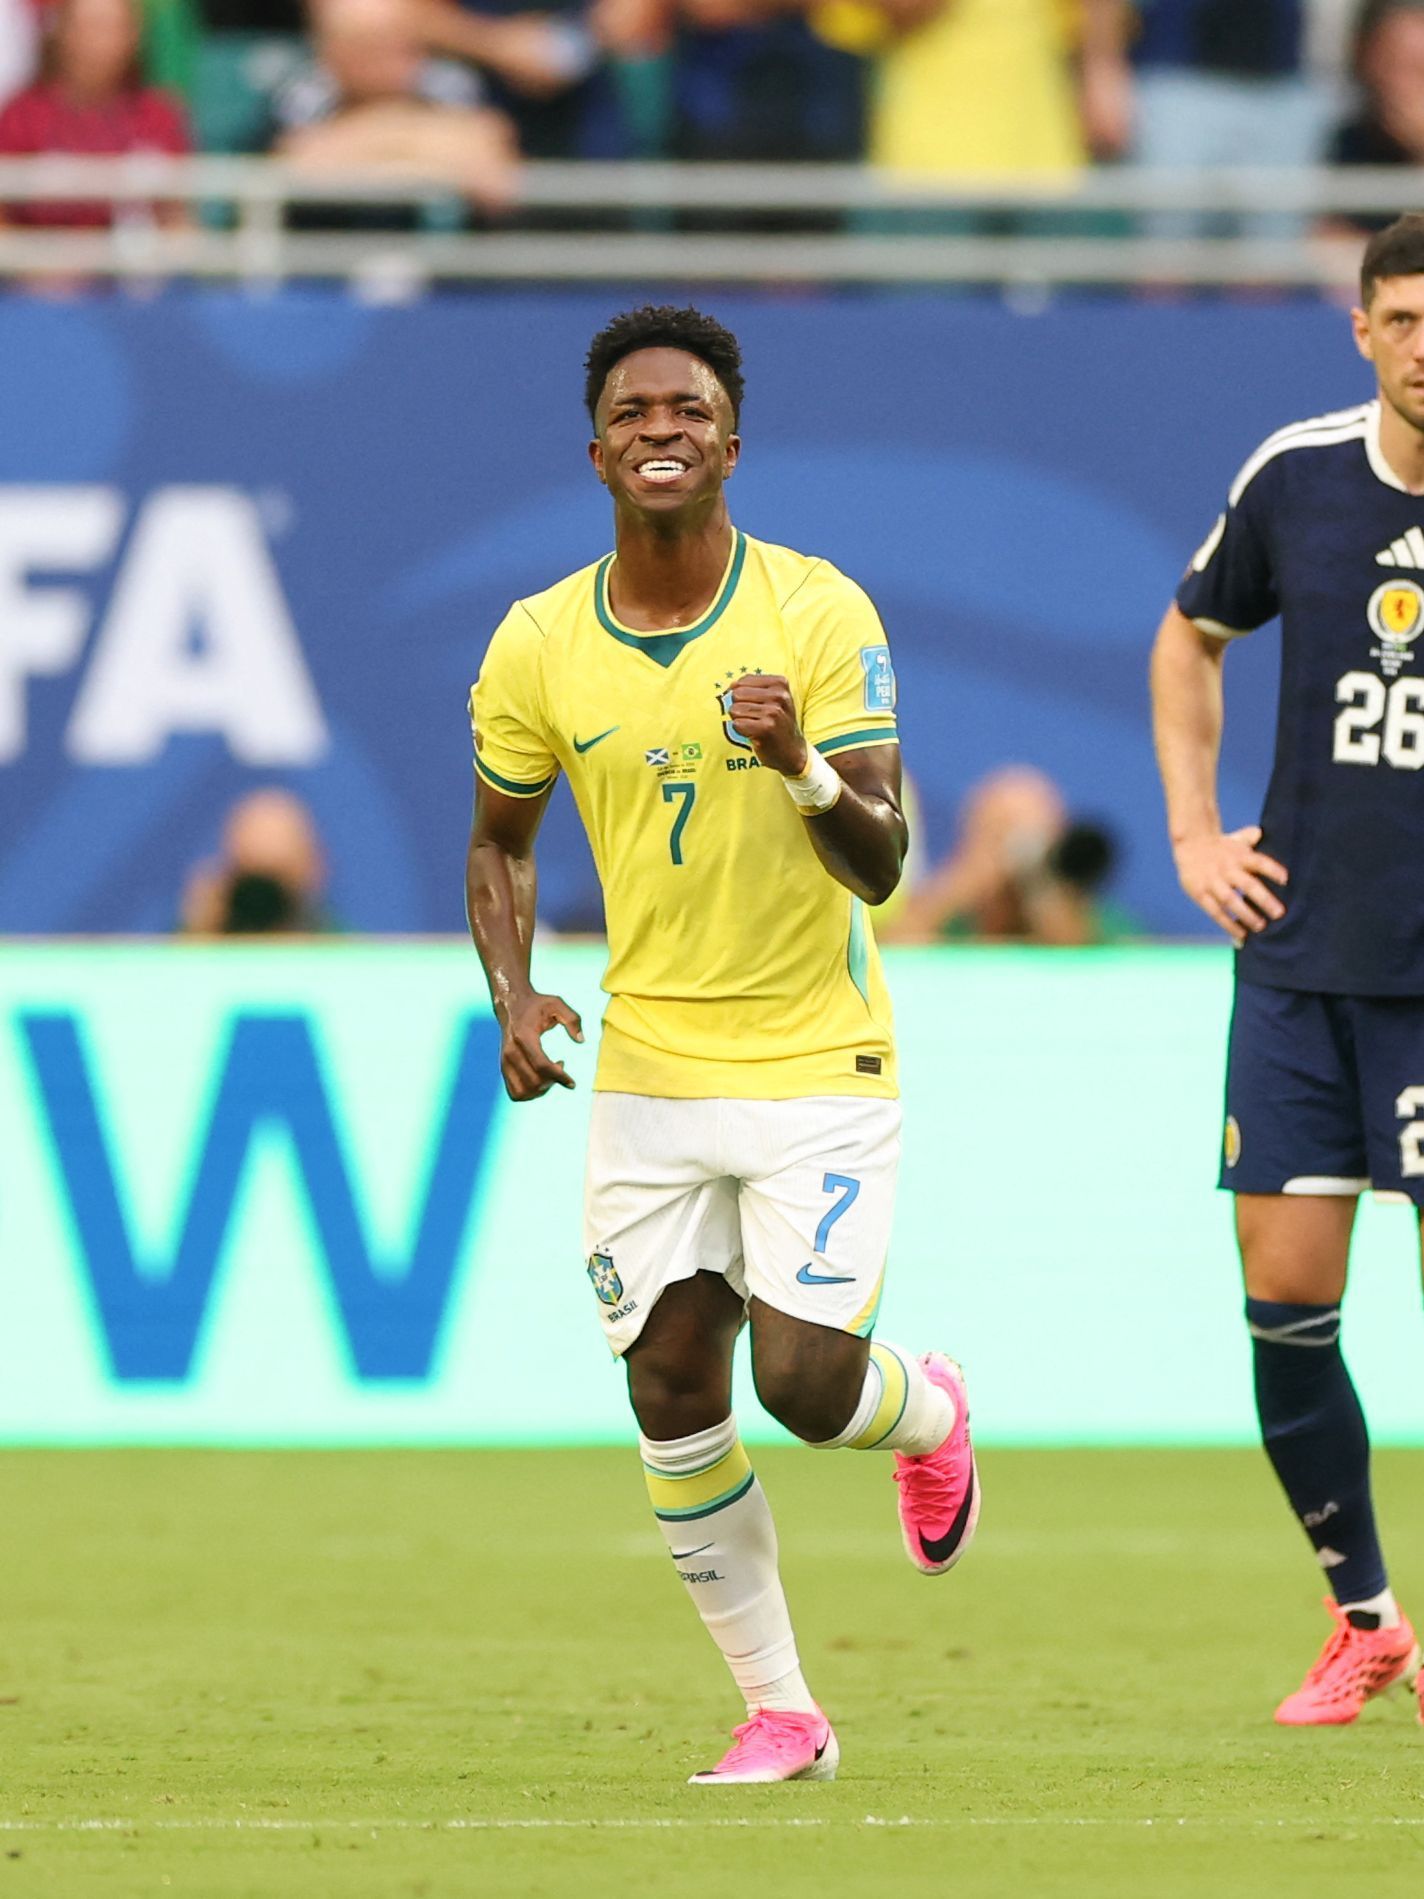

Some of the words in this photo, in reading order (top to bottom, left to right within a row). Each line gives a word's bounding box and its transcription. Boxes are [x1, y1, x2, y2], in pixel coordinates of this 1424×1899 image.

[662, 782, 695, 866] 7
[18, 1013, 506, 1382] W
[814, 1172, 861, 1254] 7
[607, 1300, 638, 1324] BRASIL
